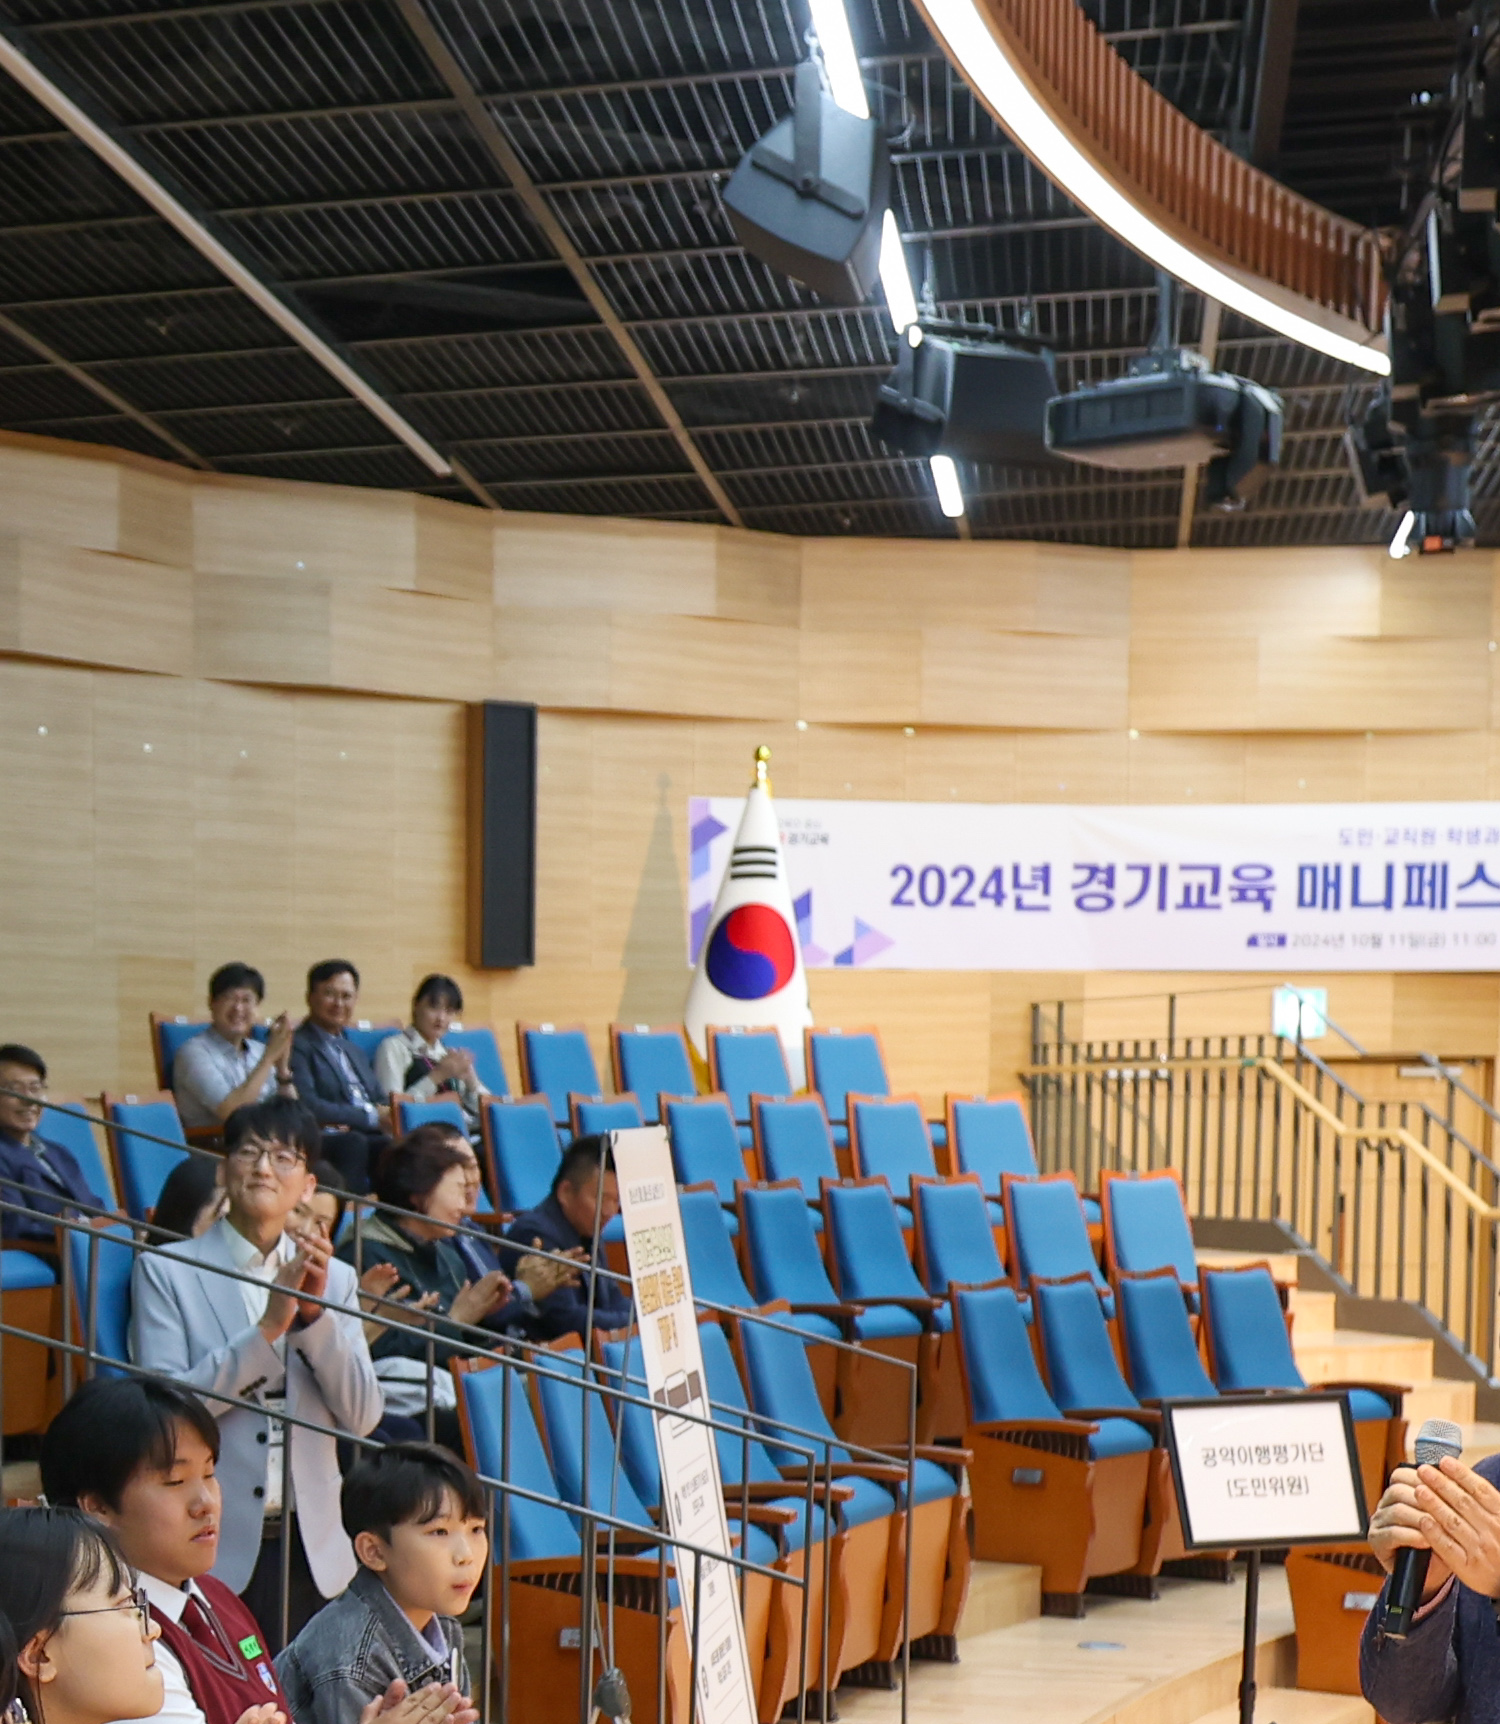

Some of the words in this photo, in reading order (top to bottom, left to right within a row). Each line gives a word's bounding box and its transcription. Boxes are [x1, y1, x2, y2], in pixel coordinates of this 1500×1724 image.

[888, 862, 1054, 912] 2024년
[1069, 861, 1277, 914] 경기교육
[1201, 1441, 1326, 1468] 공약이행평가단
